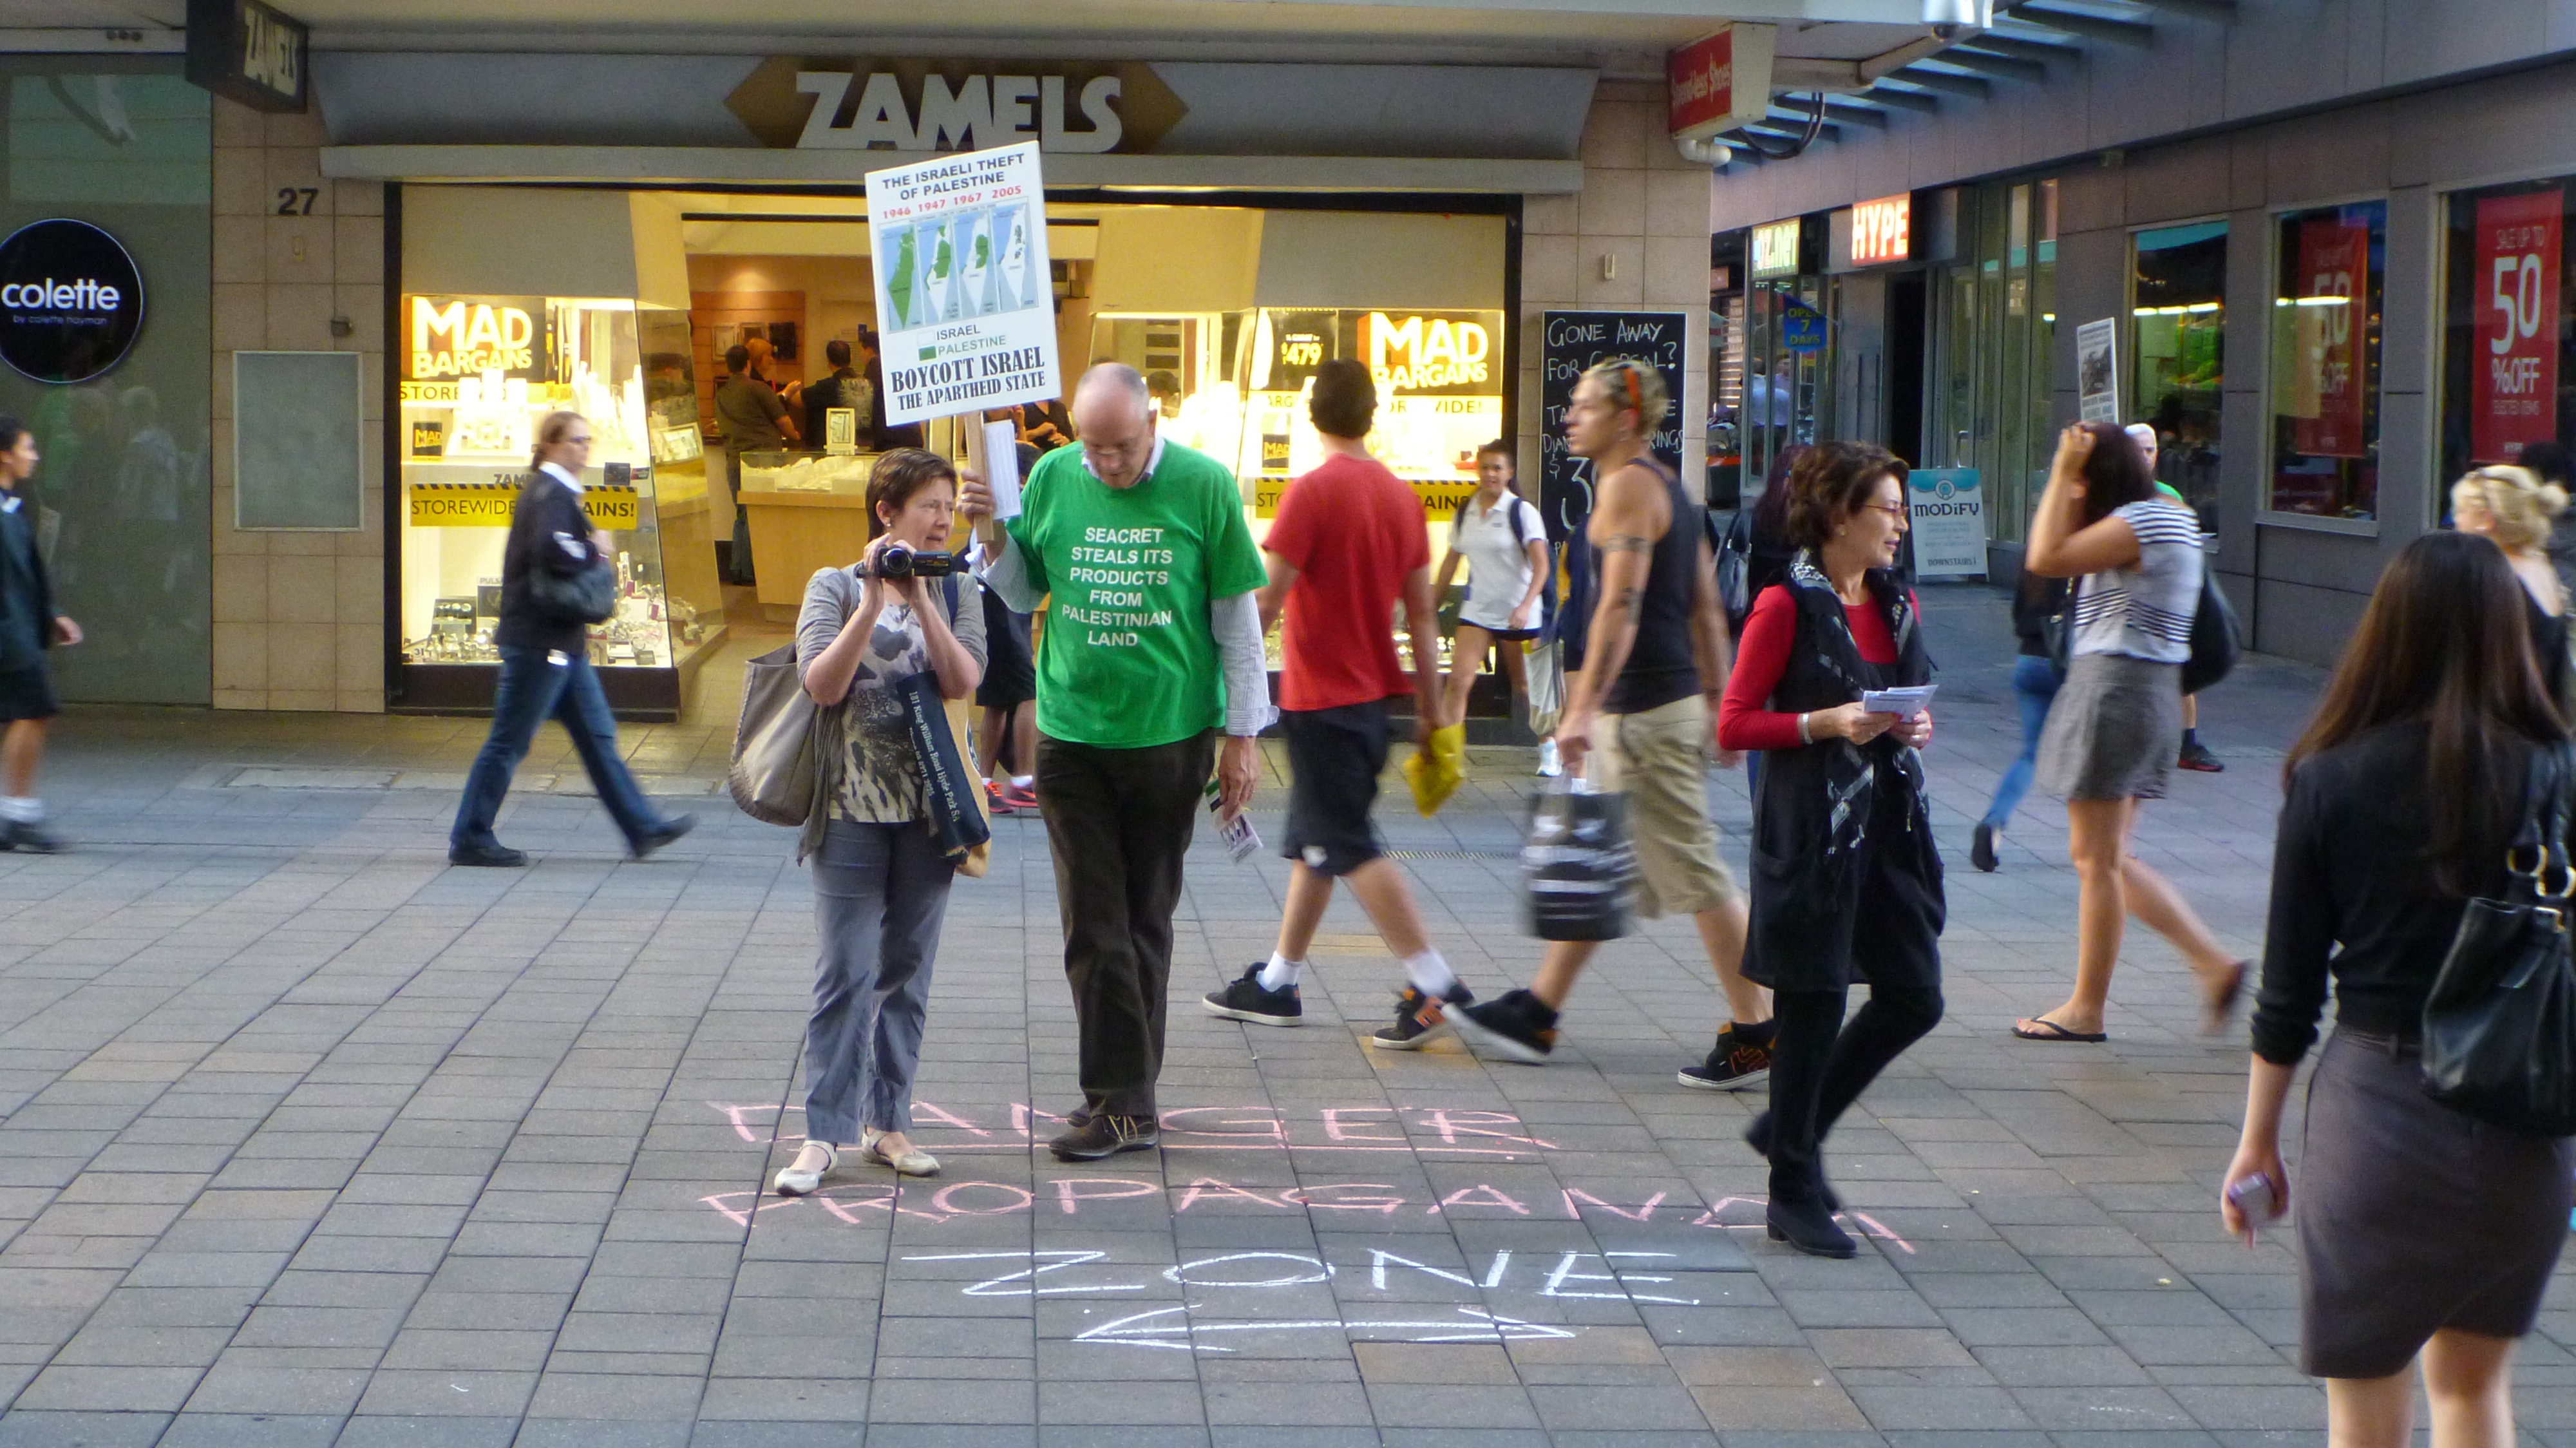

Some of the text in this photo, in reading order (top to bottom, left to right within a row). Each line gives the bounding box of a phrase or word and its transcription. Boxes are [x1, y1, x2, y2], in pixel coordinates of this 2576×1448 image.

[796, 71, 1122, 153] ZAMELS
[882, 153, 1025, 189] THE ISRAELI THEFT
[900, 171, 1005, 201] OF PALESTINE
[278, 187, 318, 214] 27
[883, 207, 911, 219] 1946
[918, 199, 946, 213] 1947
[954, 193, 982, 205] 1967
[992, 186, 1022, 199] 2005
[1852, 200, 1908, 260] HYPE
[1, 278, 121, 310] colette
[2491, 252, 2543, 355] 50
[412, 296, 533, 352] MAD
[936, 324, 981, 341] ISRAEL
[1548, 318, 1664, 347] GONE AWAY
[1801, 319, 1811, 333] 7
[938, 335, 1007, 356] PALESTINE
[1370, 312, 1489, 366] MAD
[412, 348, 532, 379] BARGAINS
[891, 346, 1045, 393] BOYCOTT ISRAEL
[1548, 358, 1581, 381] FOR
[1372, 363, 1488, 390] BARGAINS
[898, 371, 1046, 411] THE APARTHEID STATE
[415, 428, 442, 444] MAD
[411, 499, 516, 515] STOREWIDE
[1084, 527, 1164, 544] SEACRET
[1071, 546, 1173, 564] STEALS ITS
[1070, 567, 1169, 586] PRODUCTS
[1090, 589, 1142, 607] FROM
[1063, 604, 1172, 627] PALESTINIAN
[1087, 630, 1139, 647] LAND
[909, 691, 920, 705] 181
[913, 705, 924, 725] King
[920, 723, 934, 753] William
[930, 751, 944, 772] Road
[937, 771, 951, 792] Hyde
[945, 791, 958, 810] Park
[901, 1249, 1701, 1305] ZONE
